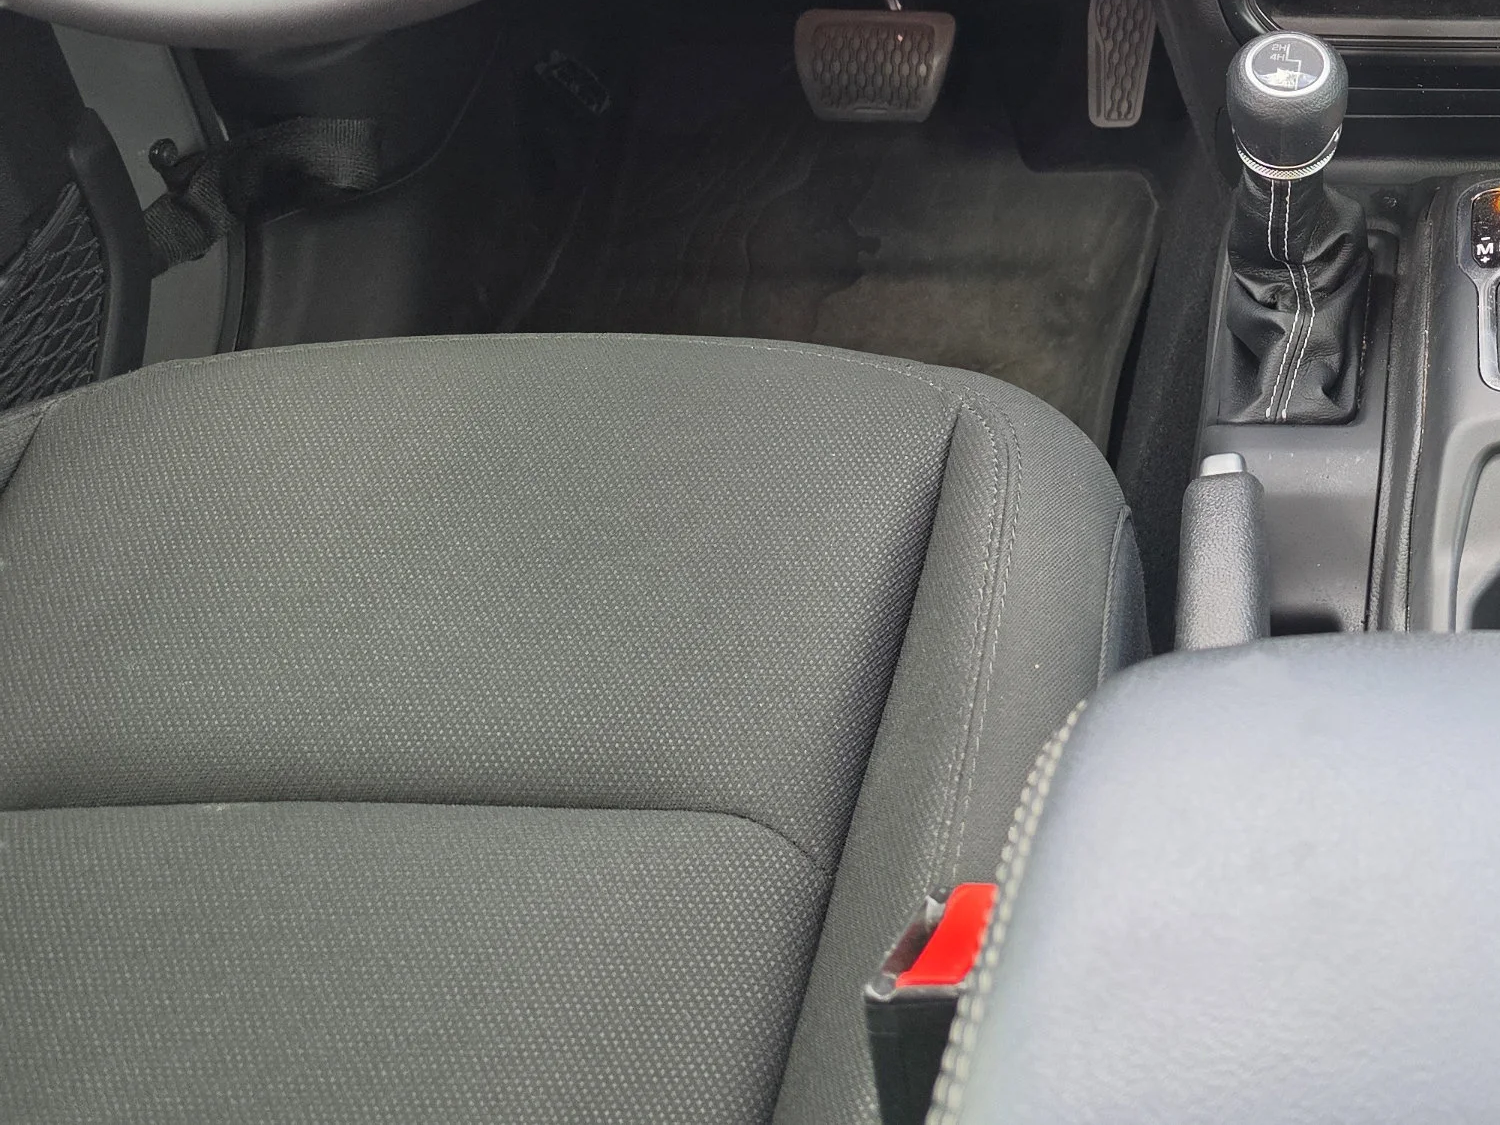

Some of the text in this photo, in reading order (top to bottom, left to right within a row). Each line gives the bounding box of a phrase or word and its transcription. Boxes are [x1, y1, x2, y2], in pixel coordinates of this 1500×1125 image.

[1271, 43, 1287, 52] 2H
[1270, 53, 1286, 62] 4H
[1476, 242, 1494, 256] M
